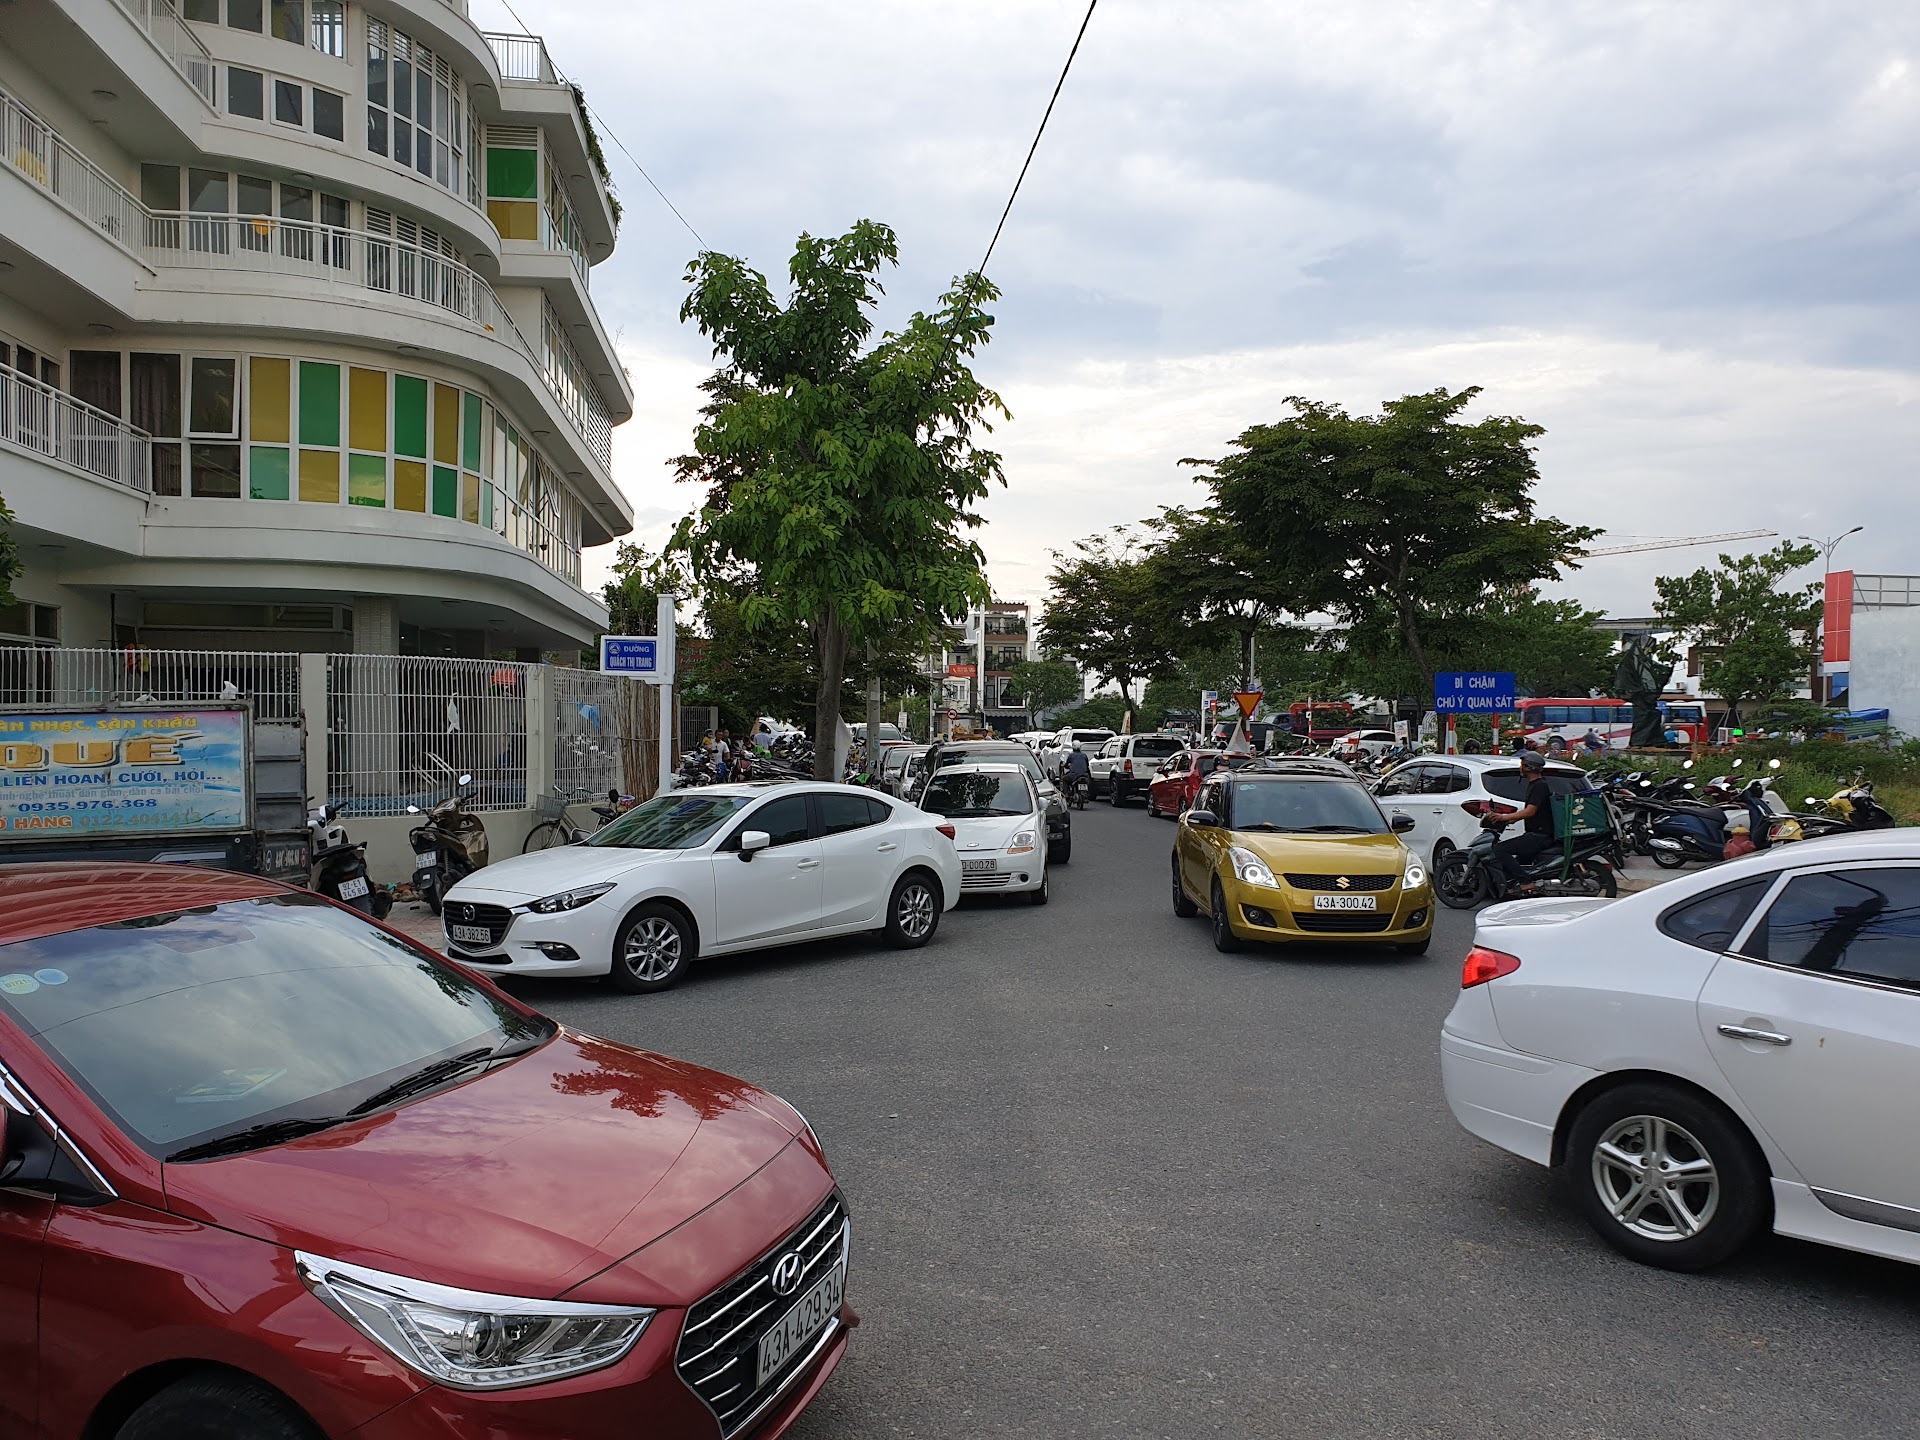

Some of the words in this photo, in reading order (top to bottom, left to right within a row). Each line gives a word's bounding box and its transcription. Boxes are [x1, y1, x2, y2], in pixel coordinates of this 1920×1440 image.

[1469, 675, 1496, 689] CHẬM
[1437, 695, 1456, 708] CHÚ
[1457, 695, 1464, 708] Ý
[1467, 697, 1492, 709] QUAN
[1495, 695, 1512, 708] SÁT
[3, 774, 47, 787] LIÊN
[14, 814, 72, 829] HÀNG
[1316, 896, 1375, 909] 43A-300.42
[761, 1273, 841, 1375] 43A-429.34
